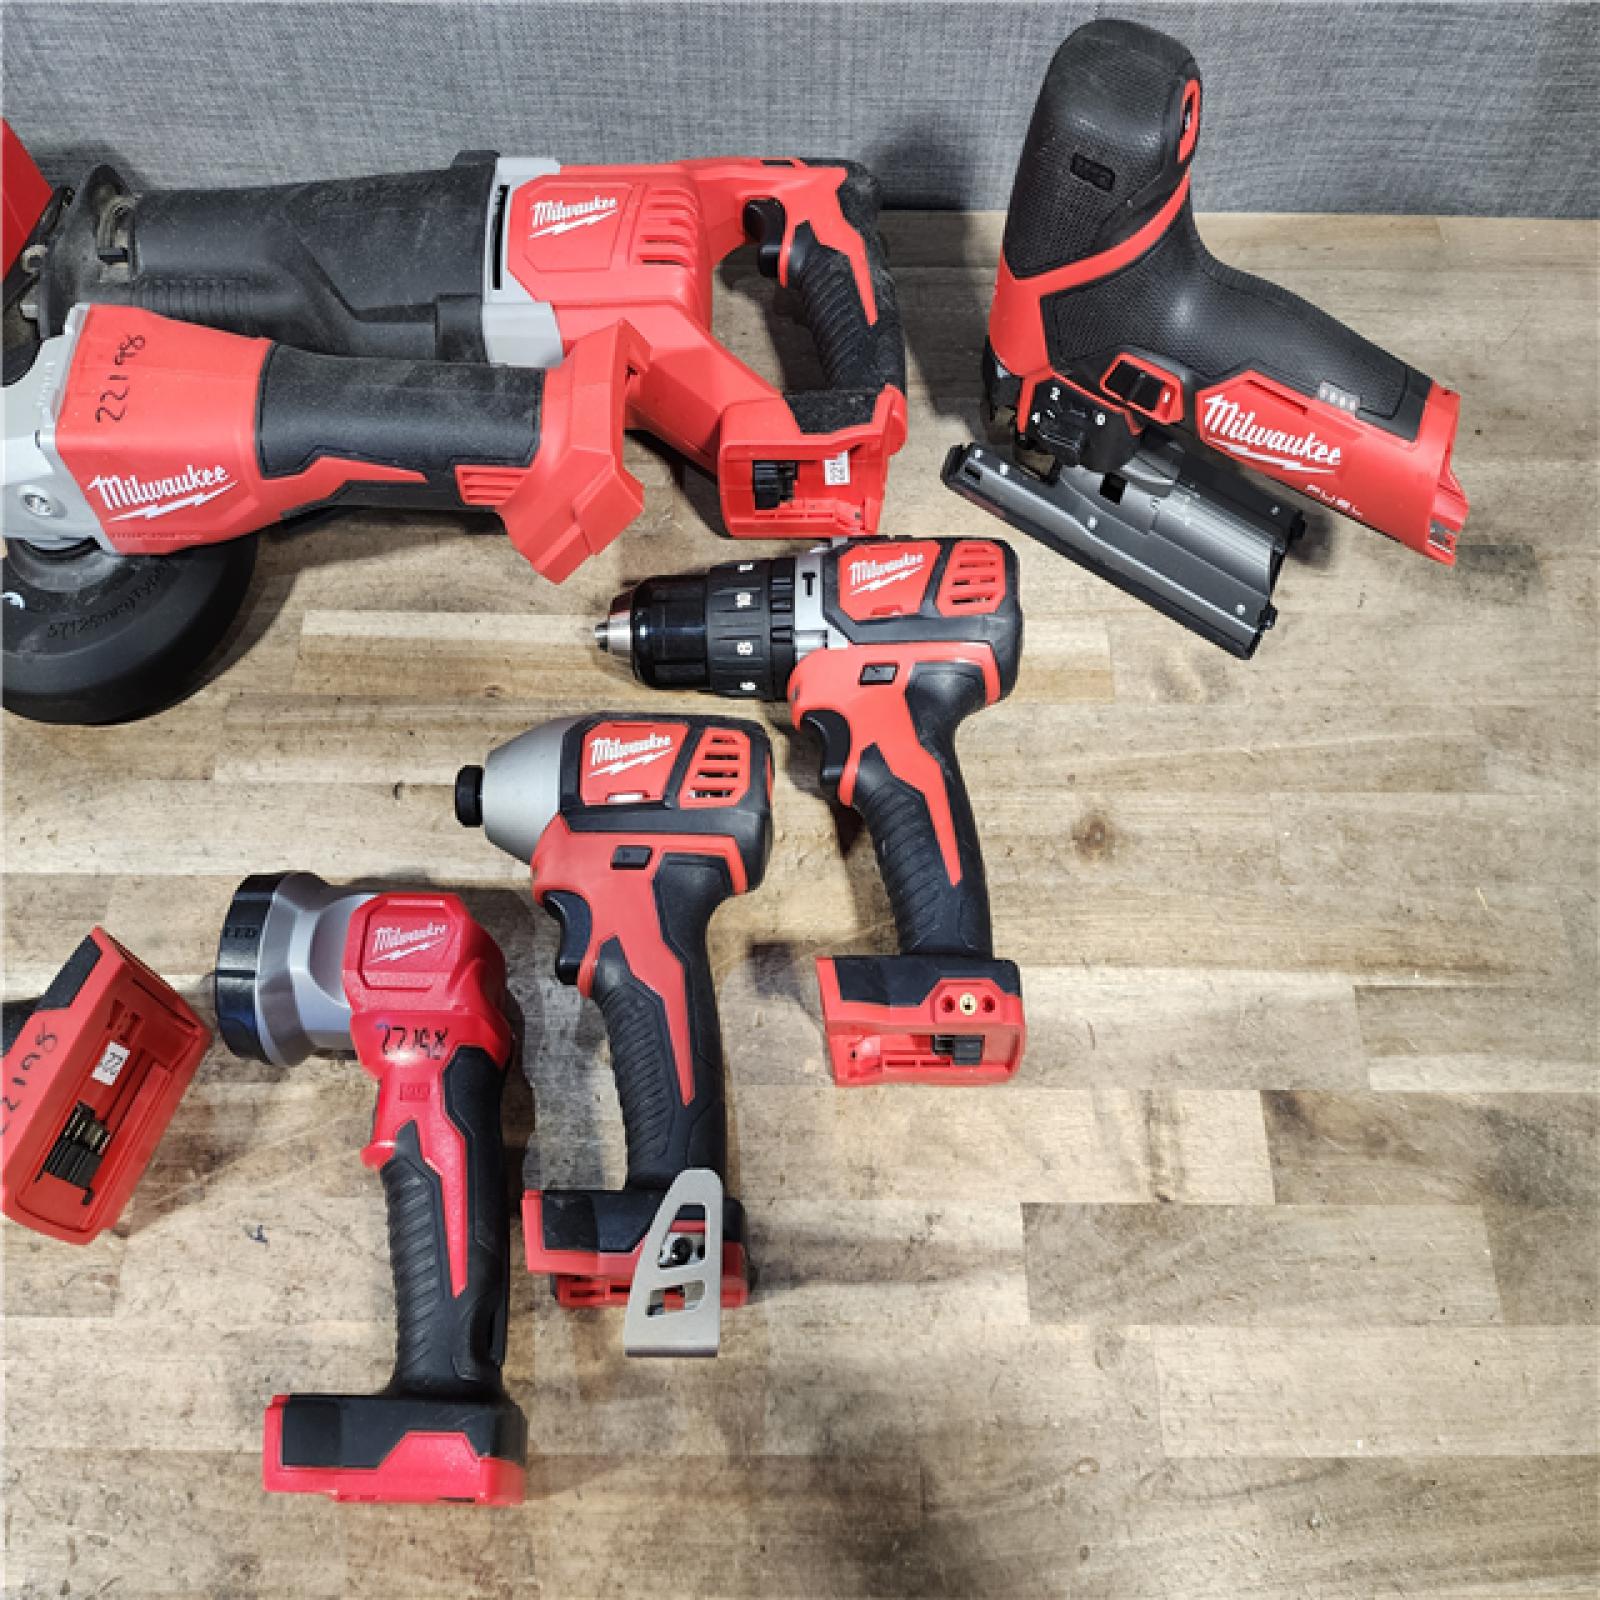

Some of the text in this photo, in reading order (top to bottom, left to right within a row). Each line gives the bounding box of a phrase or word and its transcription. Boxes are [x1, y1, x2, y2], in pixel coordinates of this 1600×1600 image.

[529, 194, 618, 229] Milwaukee
[1204, 393, 1342, 465] Milwaukee
[87, 464, 231, 510] Milwaukee
[1305, 484, 1363, 517] FUEL
[848, 552, 924, 586] Milwaukee
[590, 732, 671, 768] Milwaukee
[373, 922, 448, 957] Milwaukee
